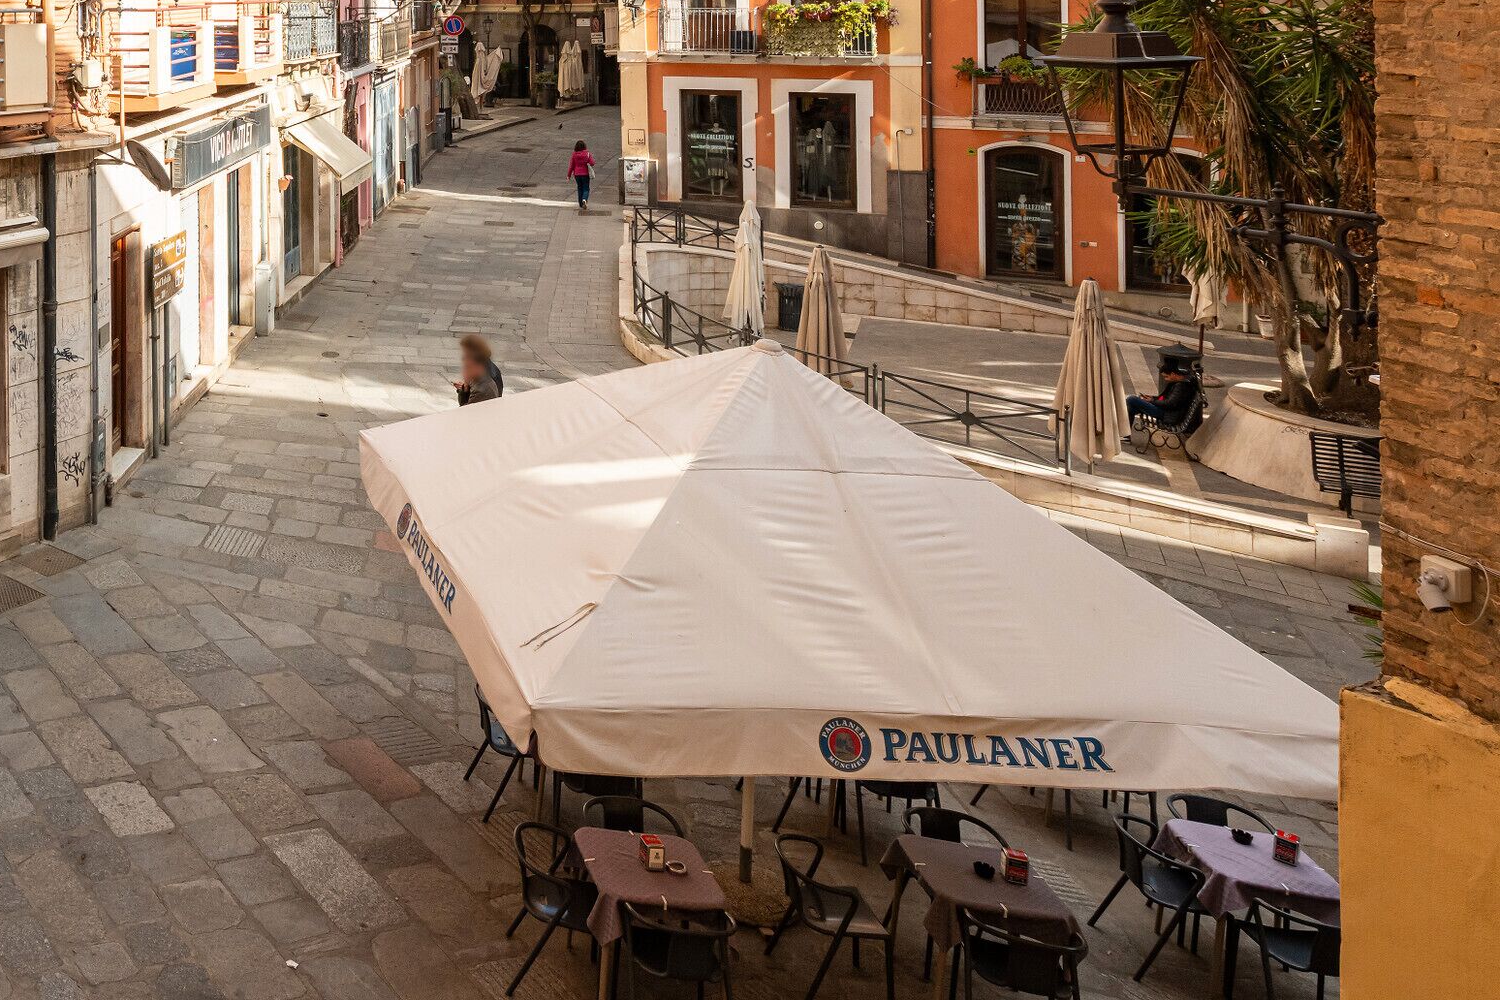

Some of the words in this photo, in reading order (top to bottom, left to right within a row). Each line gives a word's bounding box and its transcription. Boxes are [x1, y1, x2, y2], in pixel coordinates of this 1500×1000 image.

[210, 132, 225, 163] VICO
[407, 520, 456, 616] PAULANER
[822, 720, 866, 739] PAULANER
[879, 728, 1116, 773] PAULANER
